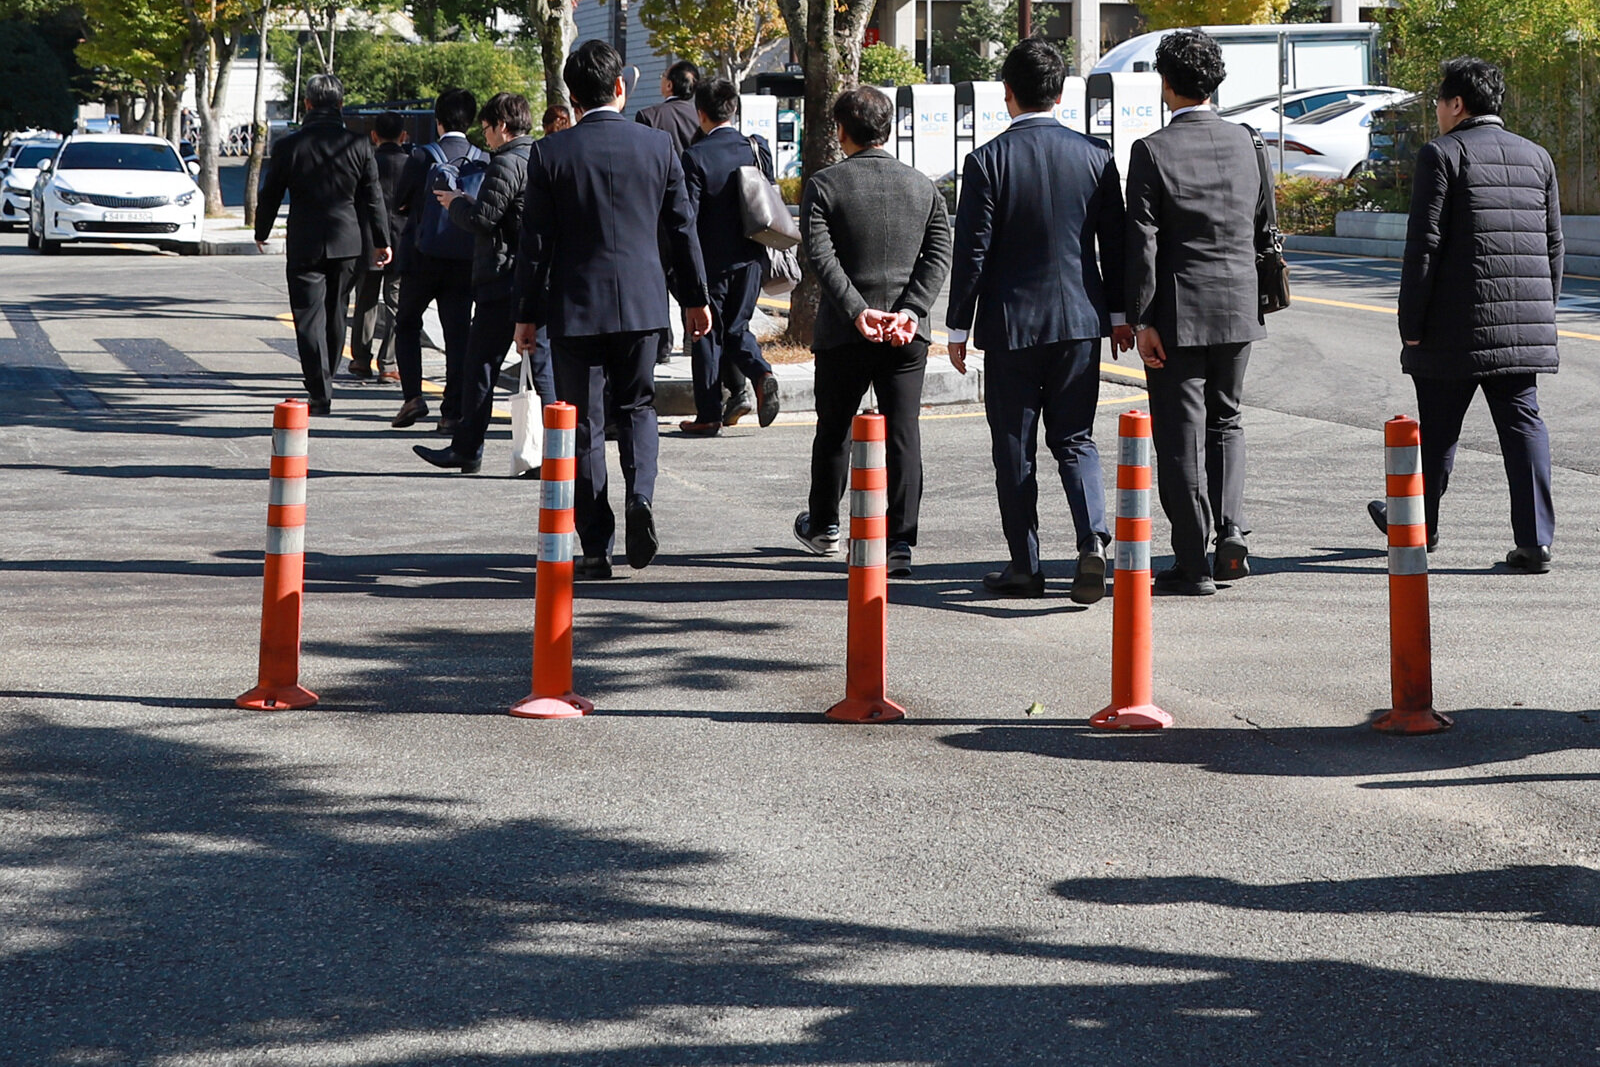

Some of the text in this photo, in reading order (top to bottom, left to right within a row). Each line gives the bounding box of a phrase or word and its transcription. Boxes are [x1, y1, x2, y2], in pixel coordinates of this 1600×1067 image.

[1121, 106, 1152, 117] NICE
[921, 112, 949, 122] NICE
[746, 119, 770, 127] NICE
